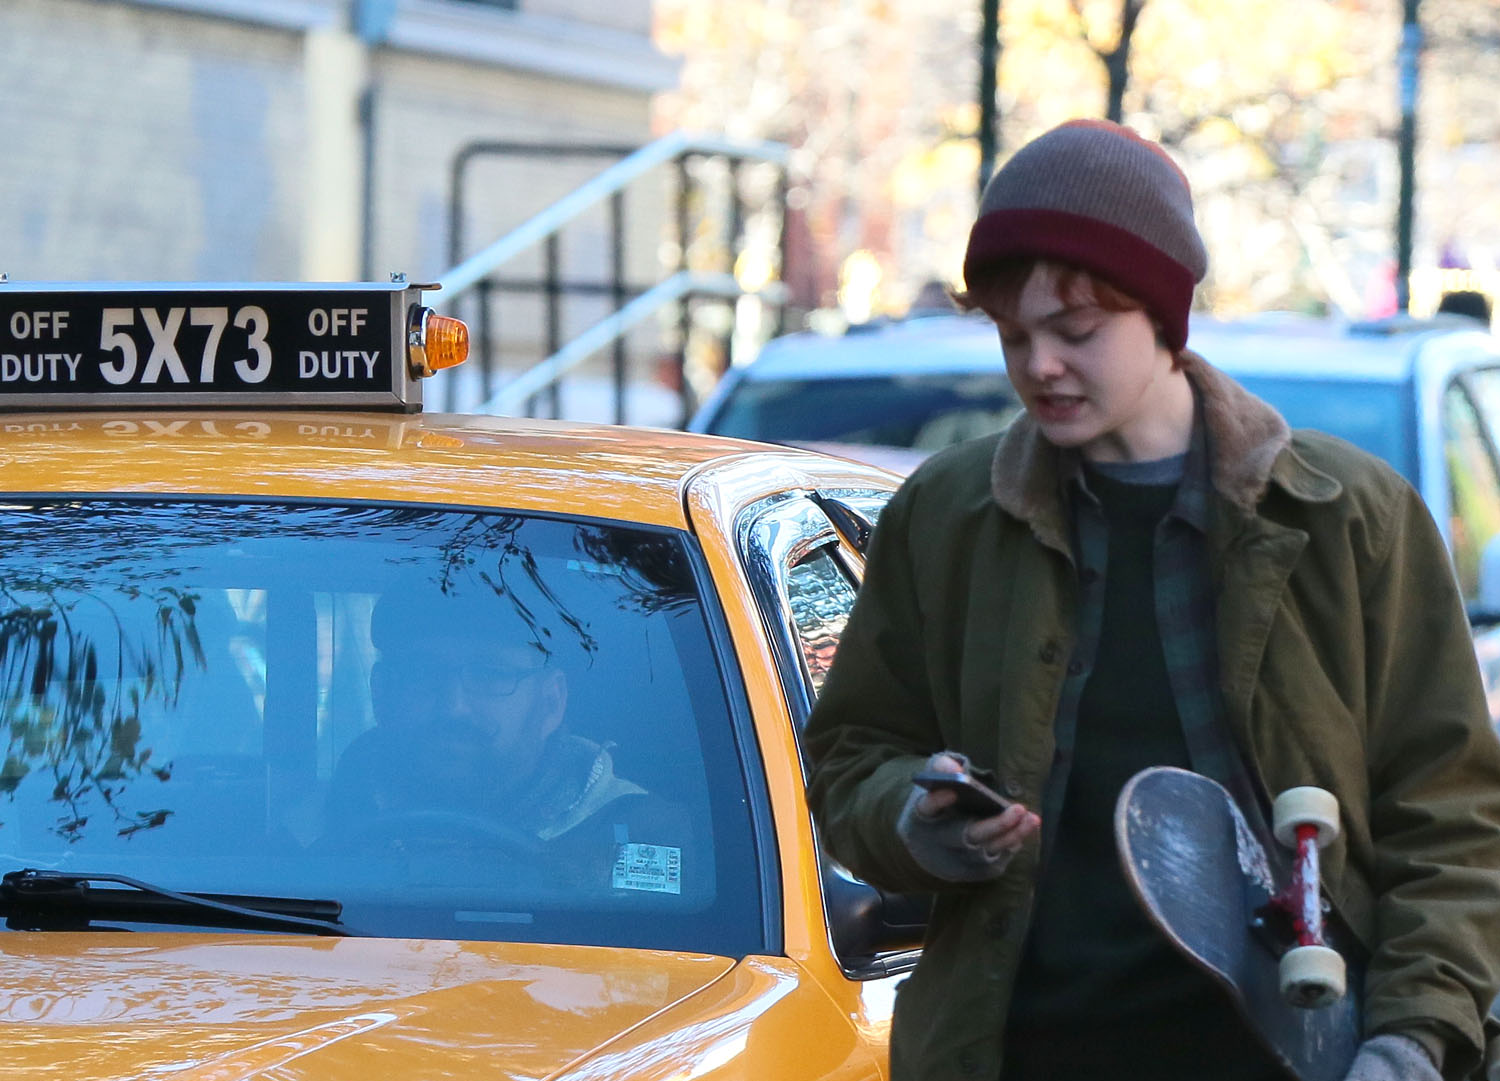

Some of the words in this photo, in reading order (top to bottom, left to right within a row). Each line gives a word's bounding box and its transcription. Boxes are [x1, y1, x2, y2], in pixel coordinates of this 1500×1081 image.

[10, 311, 70, 340] OFF
[308, 308, 368, 336] OFF
[99, 305, 273, 385] 5X73
[1, 353, 82, 382] DUTY
[299, 351, 380, 379] DUTY
